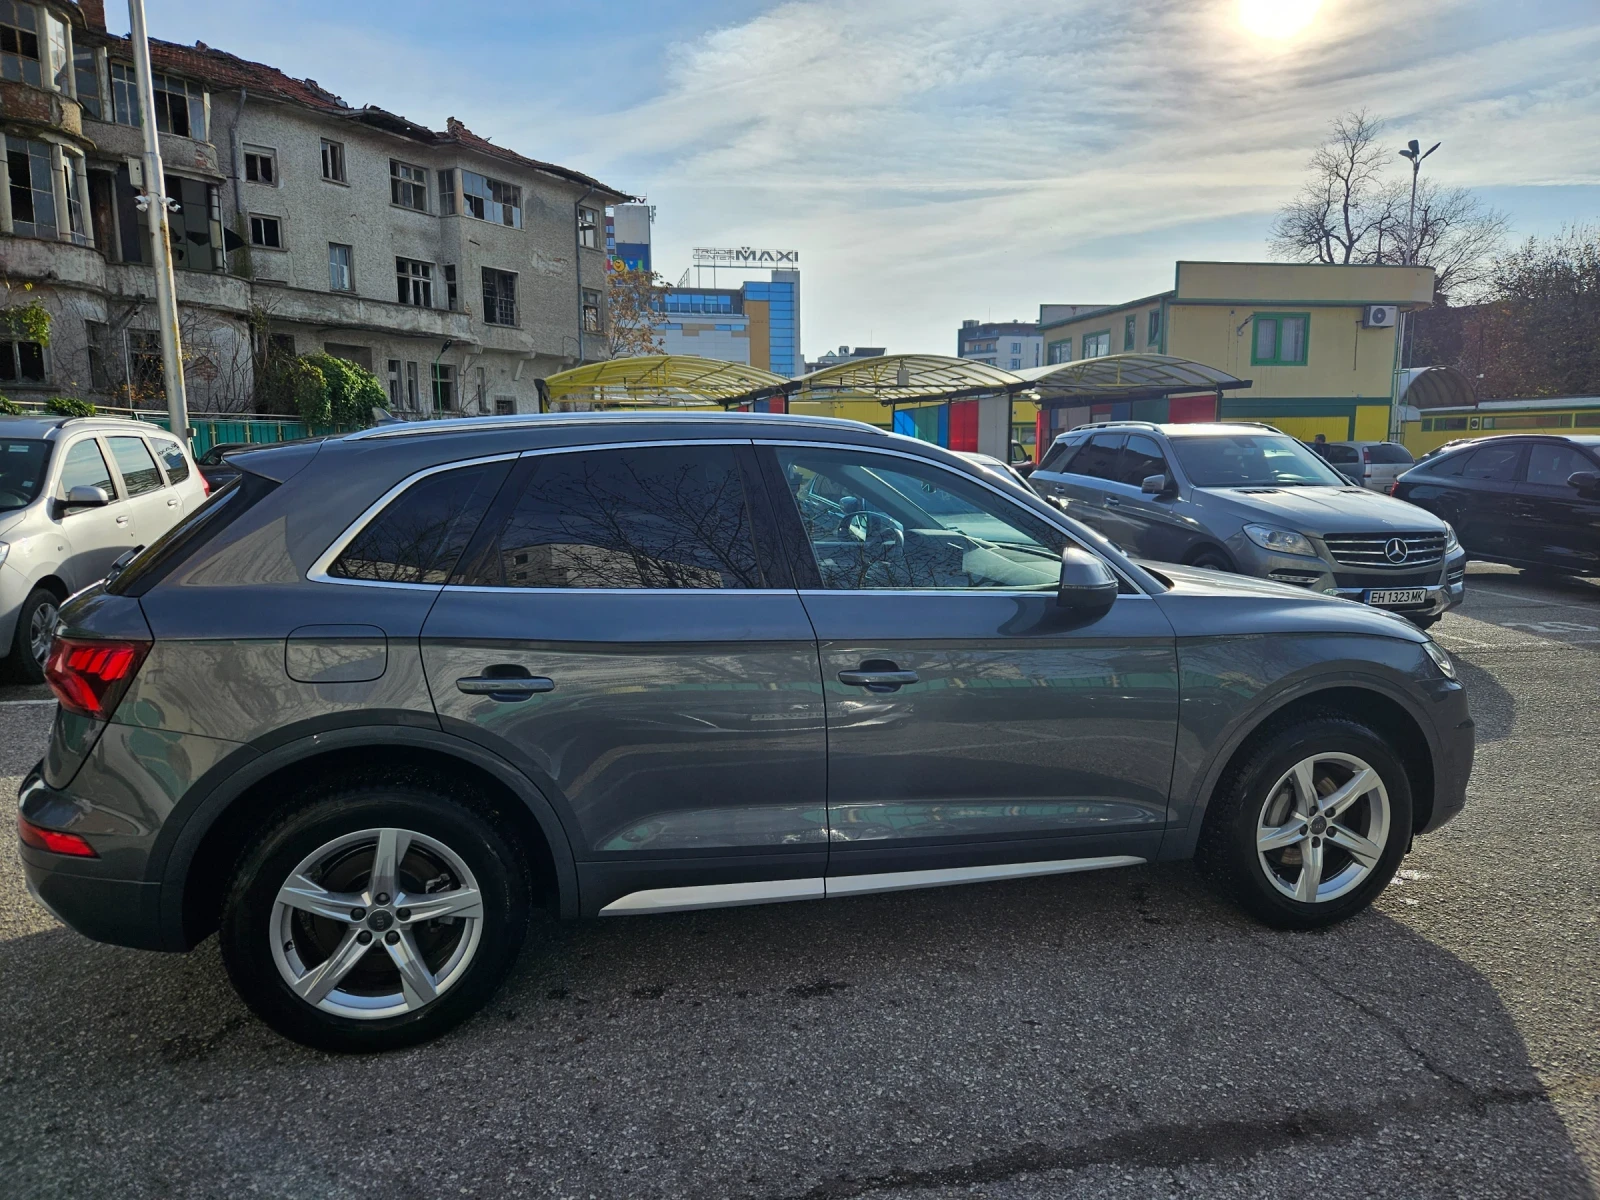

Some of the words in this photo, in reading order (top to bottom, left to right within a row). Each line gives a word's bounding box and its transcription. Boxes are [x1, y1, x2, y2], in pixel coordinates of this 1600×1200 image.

[735, 247, 799, 262] MAXI
[1371, 592, 1385, 603] EH
[1388, 592, 1410, 602] 1323
[1411, 591, 1424, 602] MK
